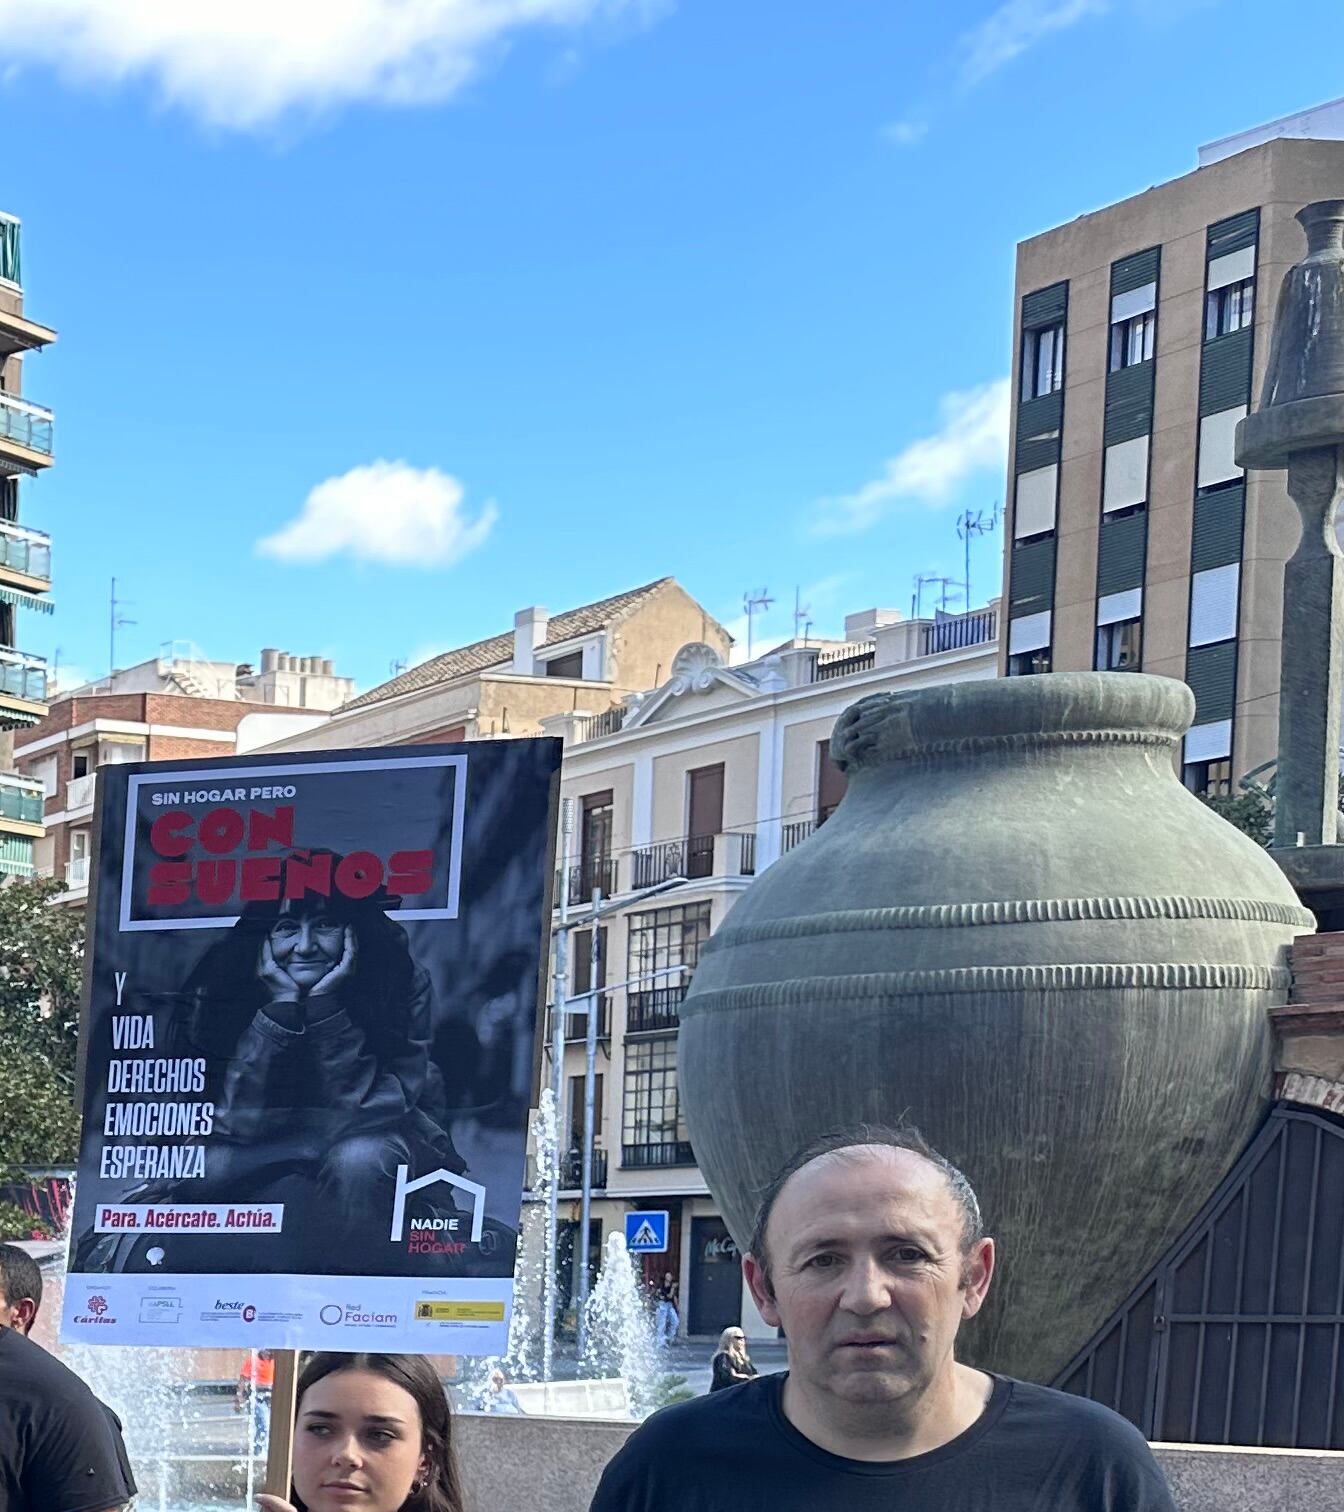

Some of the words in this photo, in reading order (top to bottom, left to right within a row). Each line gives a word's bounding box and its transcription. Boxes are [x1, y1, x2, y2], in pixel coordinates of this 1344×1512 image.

[151, 792, 180, 806] SIN
[183, 788, 247, 804] HOGAR
[250, 785, 297, 800] PERO
[150, 806, 296, 857] CON
[146, 848, 435, 906] SUEÑOS
[114, 971, 127, 1006] Y
[112, 1015, 155, 1050] VIDA
[107, 1058, 207, 1093] DERECHOS
[103, 1102, 215, 1136] EMOCIONES
[99, 1146, 206, 1179] ESPERANZA
[100, 1209, 141, 1228] Para.
[144, 1208, 222, 1228] Acércate.
[224, 1208, 277, 1228] Actúa.
[410, 1218, 459, 1231] NADIE
[408, 1242, 465, 1254] HOGAR
[409, 1230, 435, 1242] SIN
[344, 1311, 398, 1324] Faciam
